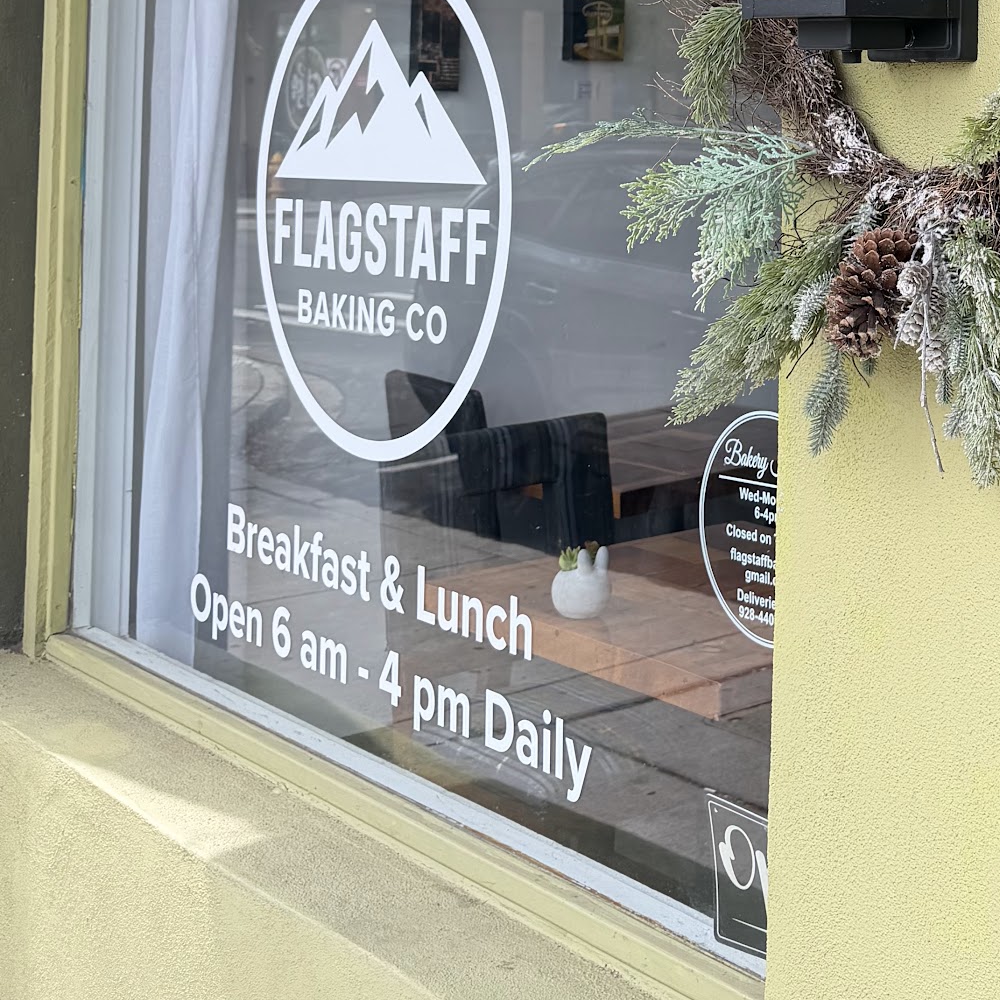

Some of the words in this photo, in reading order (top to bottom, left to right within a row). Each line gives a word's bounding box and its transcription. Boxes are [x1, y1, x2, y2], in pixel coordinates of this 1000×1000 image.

[274, 197, 491, 285] FLAGSTAFF
[297, 288, 396, 337] BAKING
[405, 302, 448, 345] CO
[724, 438, 769, 479] Bakery
[725, 523, 758, 542] Closed
[759, 533, 772, 545] on
[754, 506, 777, 525] 6-4p
[226, 502, 371, 602] Breakfast
[379, 555, 405, 615] &
[416, 564, 532, 661] Lunch
[189, 573, 263, 648] Open
[271, 606, 291, 658] 6
[299, 629, 347, 685] am
[378, 650, 402, 707] 4
[412, 674, 470, 739] pm
[484, 688, 592, 803] Daily
